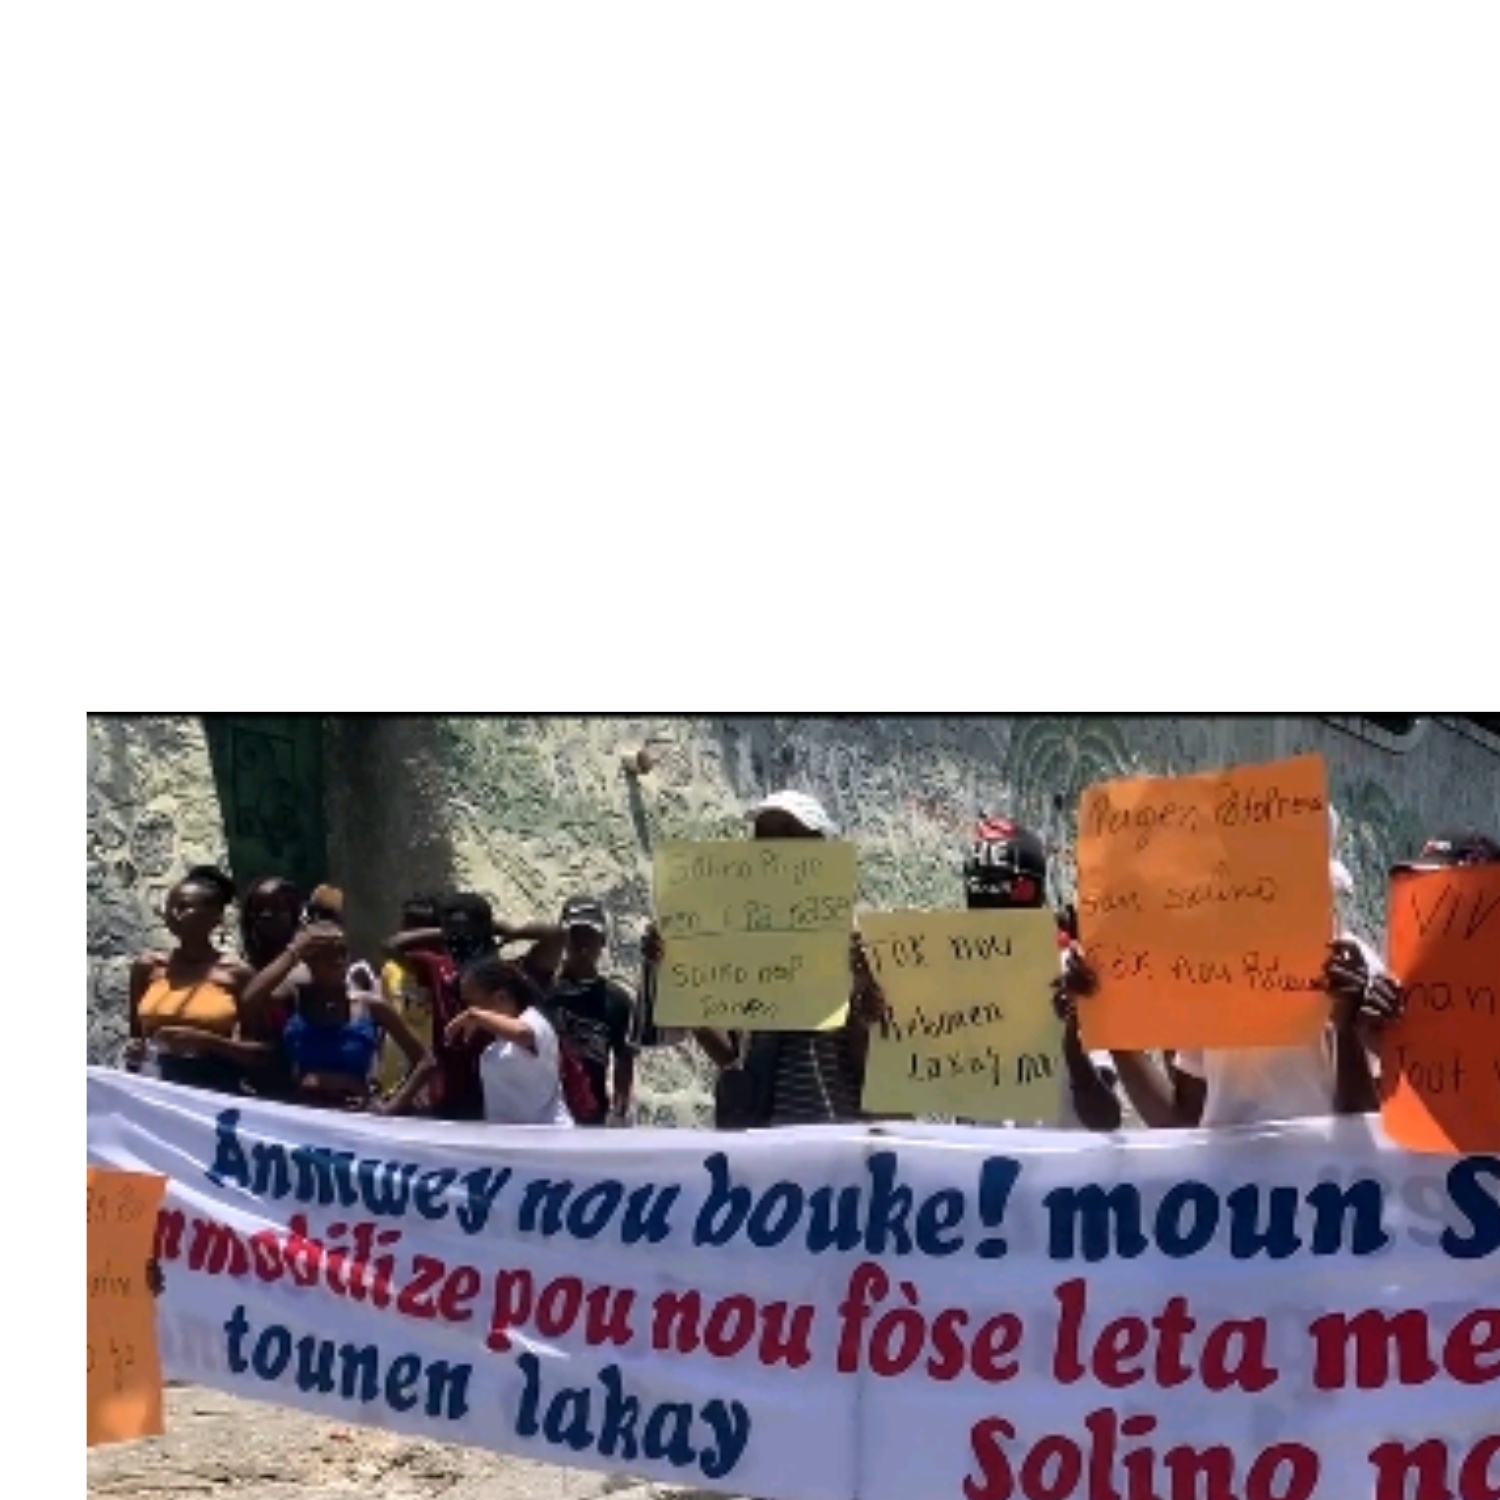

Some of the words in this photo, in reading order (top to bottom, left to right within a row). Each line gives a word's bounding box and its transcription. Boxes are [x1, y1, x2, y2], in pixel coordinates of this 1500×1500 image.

[518, 1178, 681, 1245] nou
[693, 1150, 1022, 1260] bouke!
[1042, 1178, 1389, 1263] moun
[222, 1303, 474, 1421] tounen
[514, 1351, 753, 1481] lakay
[485, 1266, 637, 1351] pou
[651, 1287, 815, 1369] nou
[836, 1260, 1024, 1383] fòse
[1052, 1276, 1279, 1393] leta
